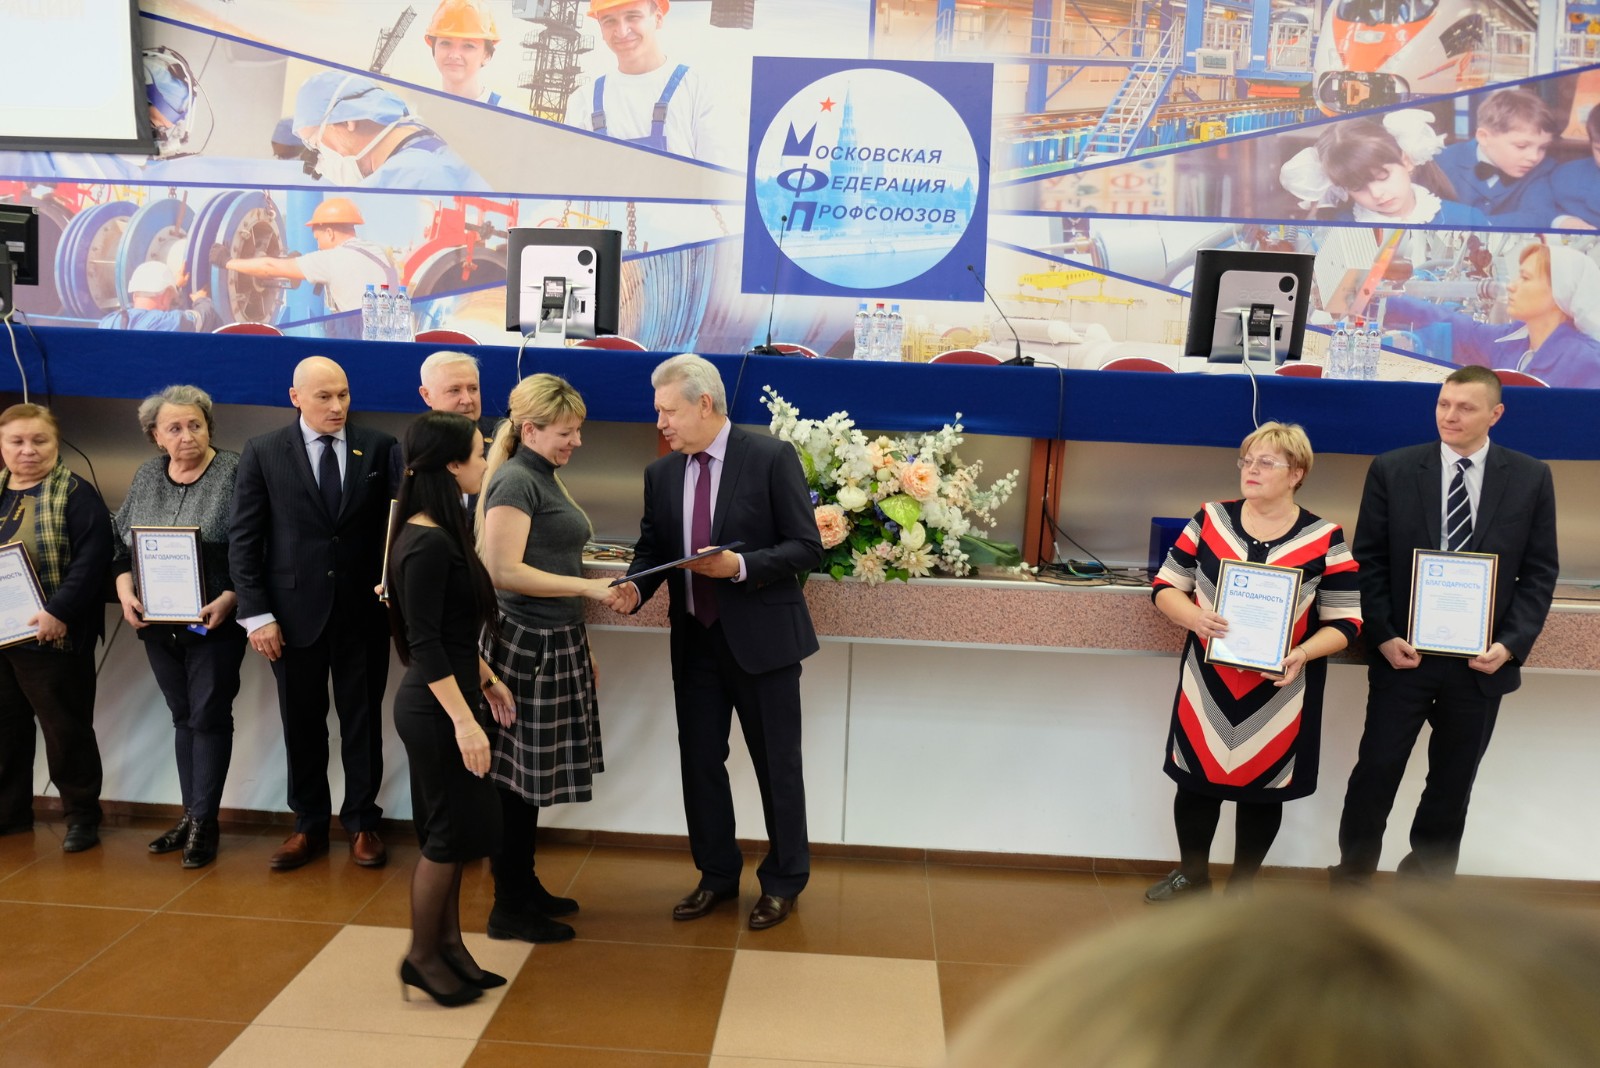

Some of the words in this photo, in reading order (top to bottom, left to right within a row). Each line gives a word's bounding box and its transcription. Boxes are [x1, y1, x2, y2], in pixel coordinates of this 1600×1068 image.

[781, 120, 943, 164] МОСКОВСКАЯ
[776, 163, 946, 198] ФЕДЕРАЦИЯ
[785, 201, 957, 232] ПРОФСОЮЗОВ
[144, 553, 191, 561] БЛАГОДАРНОСТЬ
[1425, 579, 1481, 590] БЛАГОДАРНОСТЬ
[1229, 589, 1284, 604] БЛАГОДАРНОСТЬ
